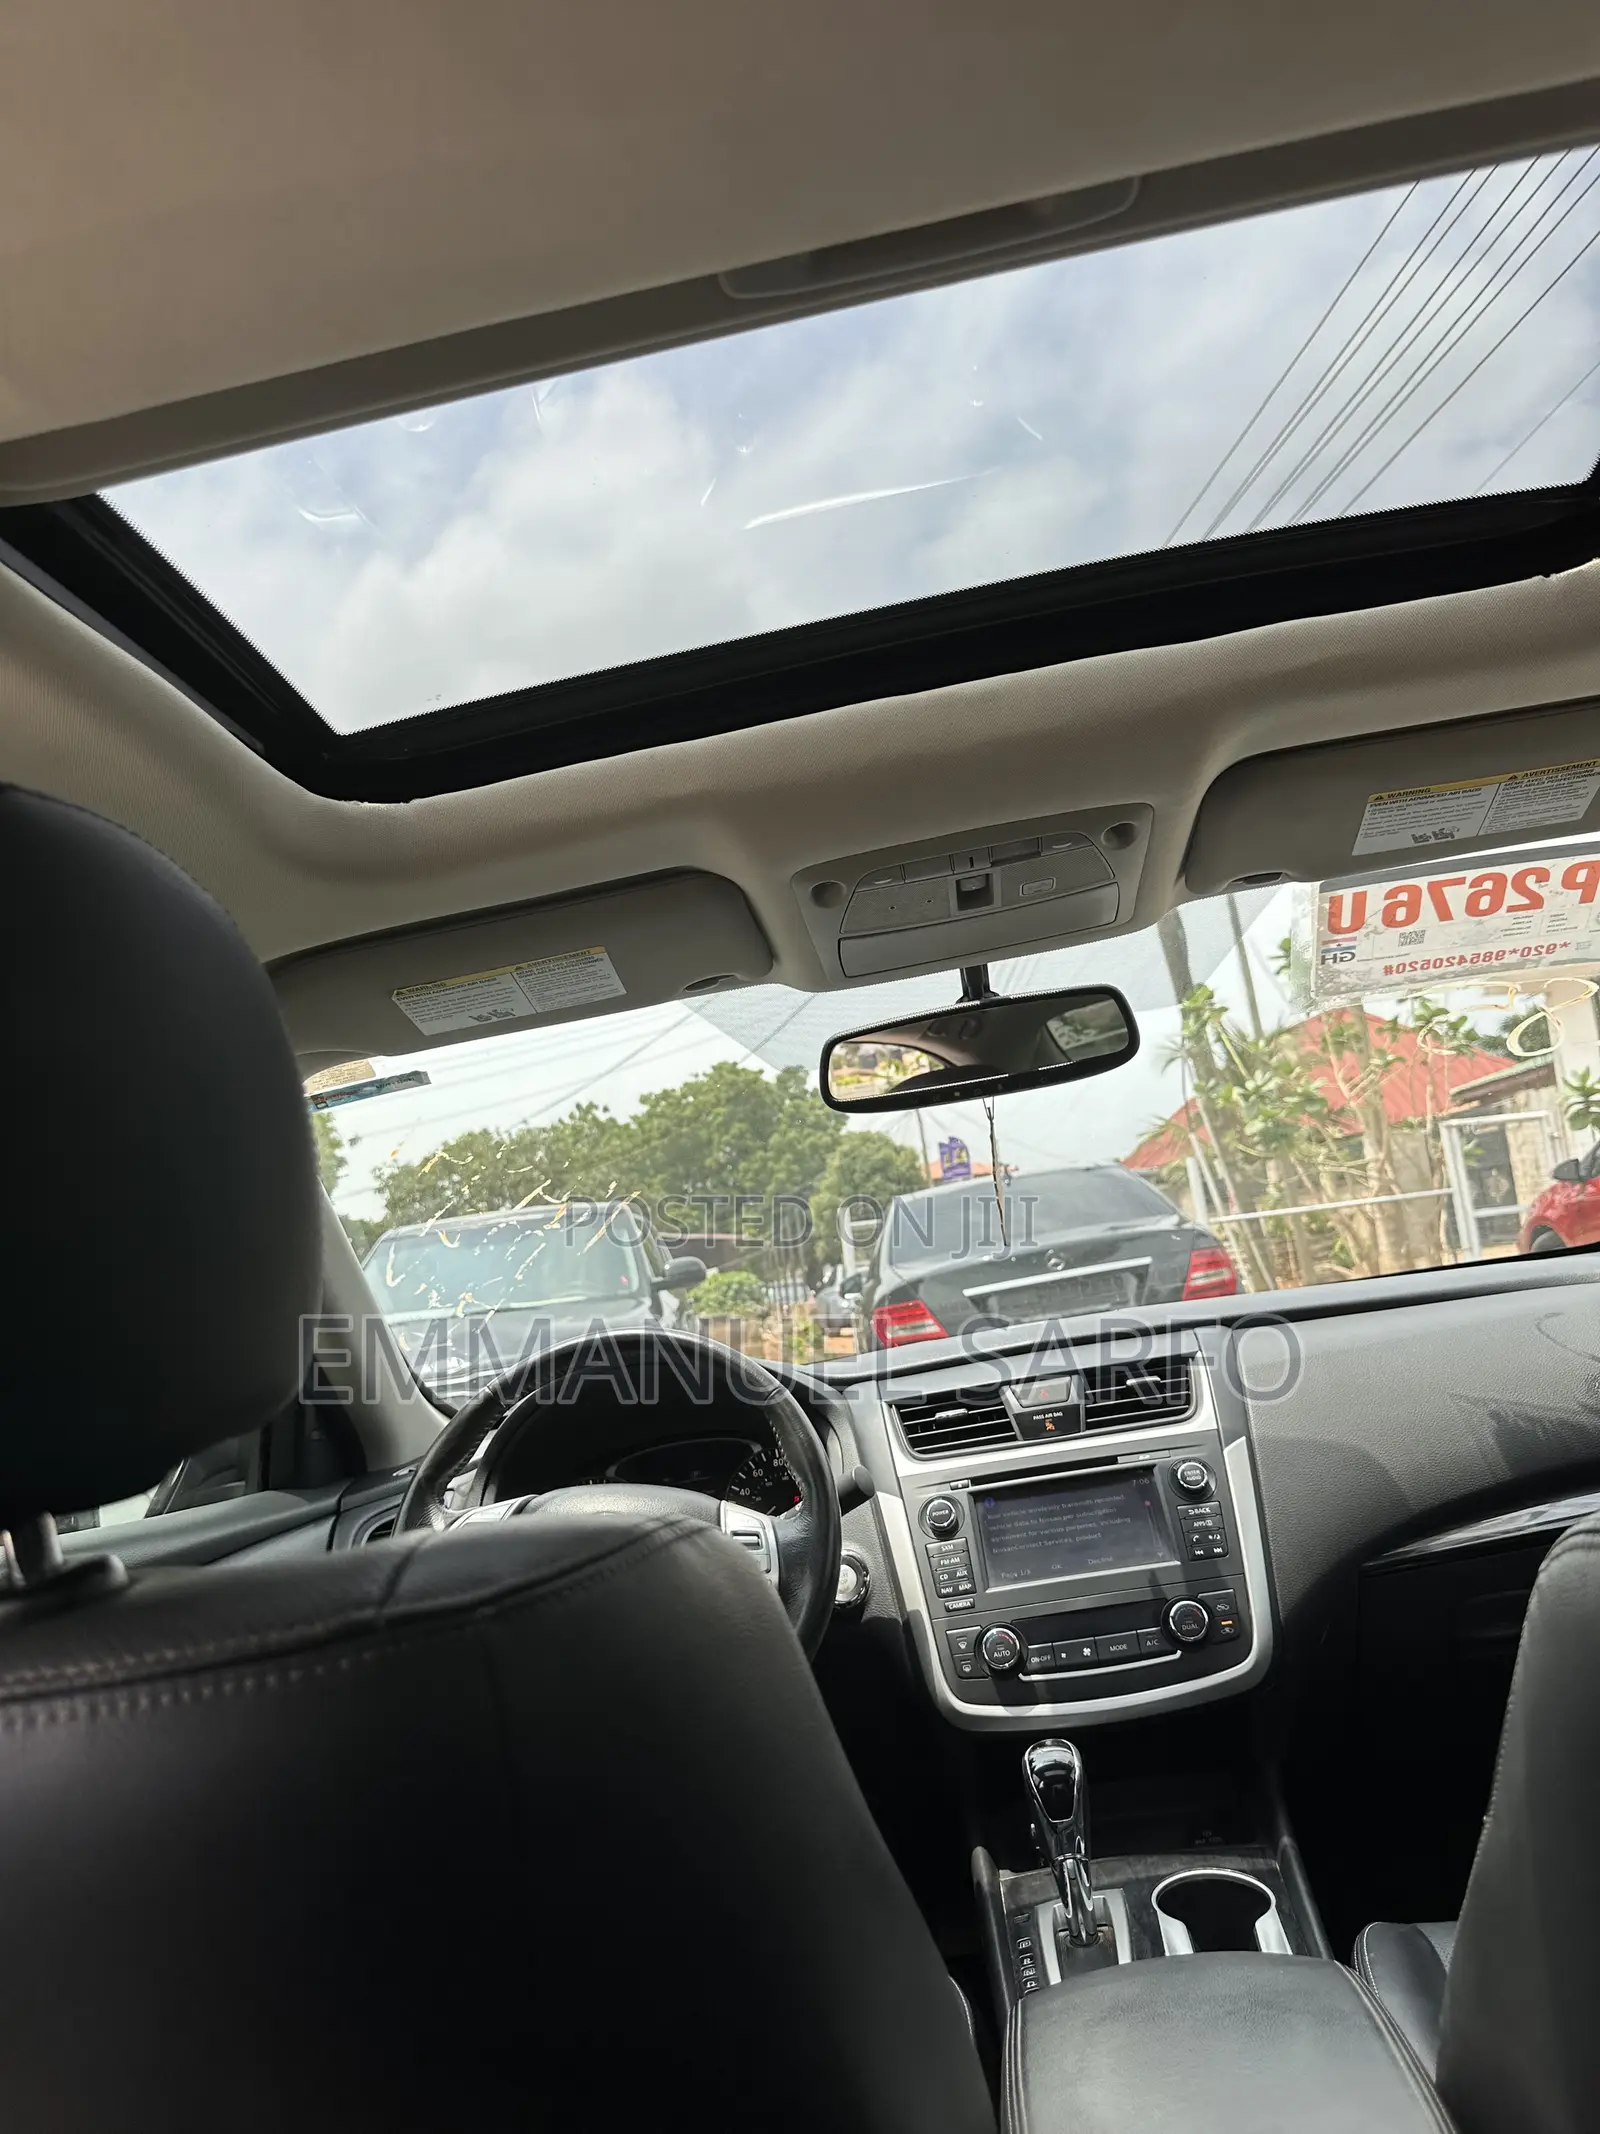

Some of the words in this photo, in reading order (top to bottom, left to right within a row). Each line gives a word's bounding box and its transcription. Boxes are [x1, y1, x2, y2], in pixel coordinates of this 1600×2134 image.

[1387, 787, 1432, 799] WARNING
[773, 1458, 784, 1467] 80
[752, 1468, 763, 1478] 60
[1132, 1477, 1150, 1487] 7:06
[739, 1487, 751, 1496] 40
[932, 1509, 949, 1517] POWER
[1194, 1506, 1212, 1514] BACK
[939, 1573, 949, 1581] CD
[956, 1570, 968, 1578] AUX
[941, 1586, 954, 1594] NAV
[958, 1583, 972, 1591] MAP
[948, 1601, 972, 1610] CAMERA
[1181, 1621, 1199, 1631] DUAL
[1109, 1643, 1128, 1652] MODE
[1146, 1638, 1160, 1648] A/C
[993, 1648, 1011, 1659] AUTO
